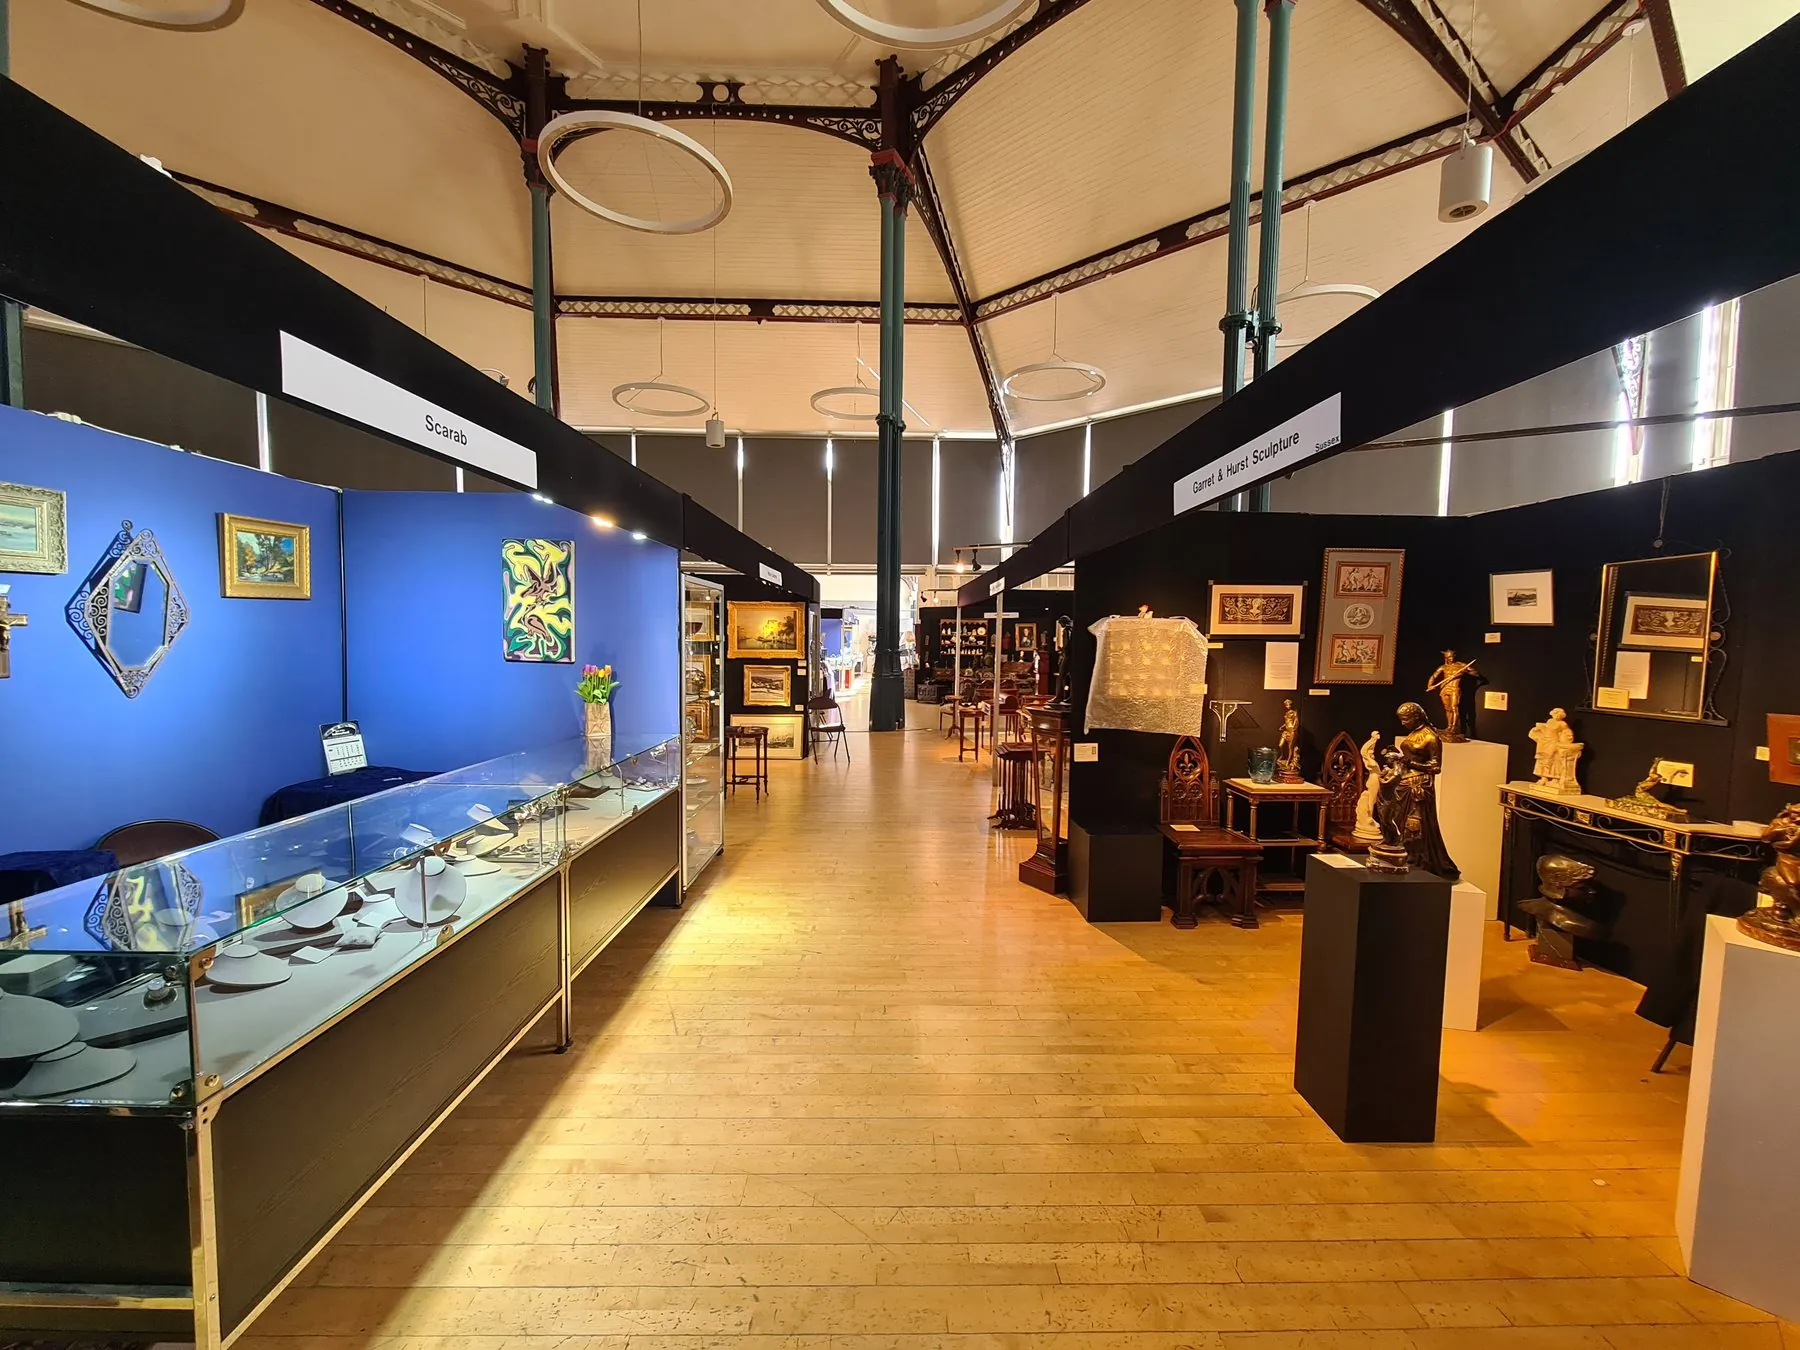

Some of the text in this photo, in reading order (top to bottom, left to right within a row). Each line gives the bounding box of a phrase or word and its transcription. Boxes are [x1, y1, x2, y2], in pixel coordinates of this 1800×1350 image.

[425, 415, 468, 446] Scarab
[1315, 436, 1340, 452] Sussex
[1193, 432, 1299, 493] Garret & Hurst Sculpture
